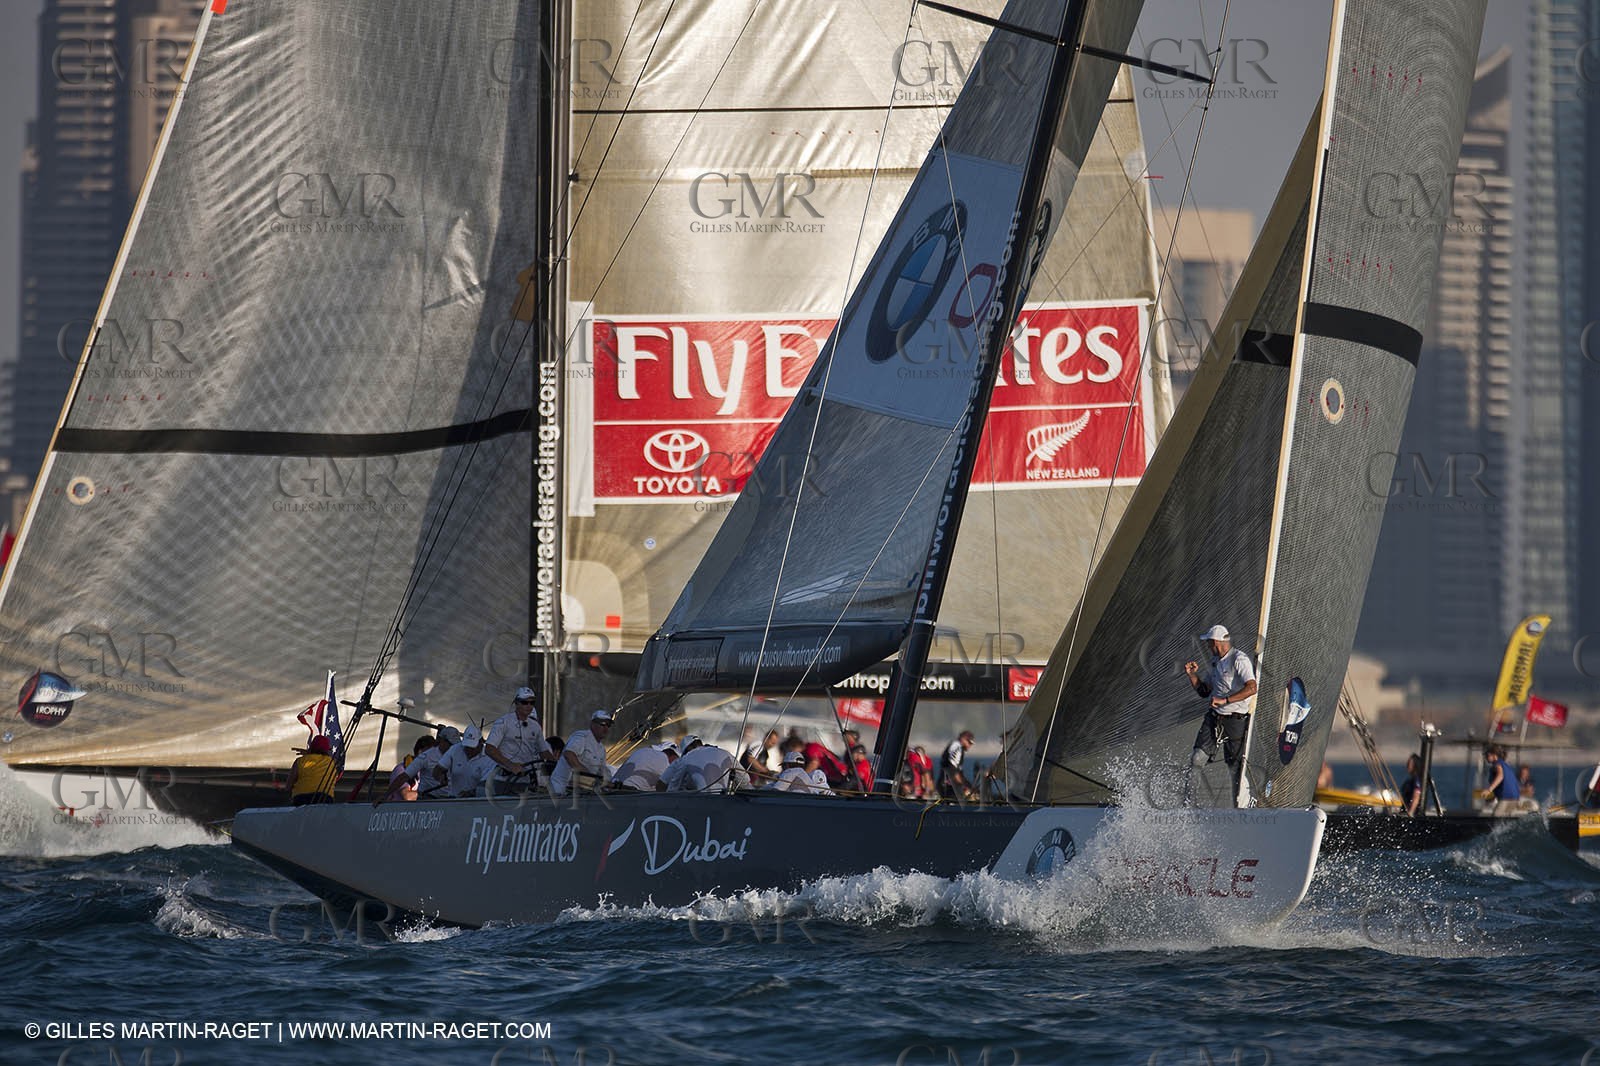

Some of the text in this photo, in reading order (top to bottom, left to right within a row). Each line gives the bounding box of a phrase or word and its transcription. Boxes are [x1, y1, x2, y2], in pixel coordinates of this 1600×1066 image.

[615, 326, 749, 415] Fly
[633, 476, 721, 493] TOYOTA
[1026, 467, 1099, 480] NEW ZEALAND
[465, 811, 580, 875] Fly Emirates
[641, 815, 752, 875] Dubai
